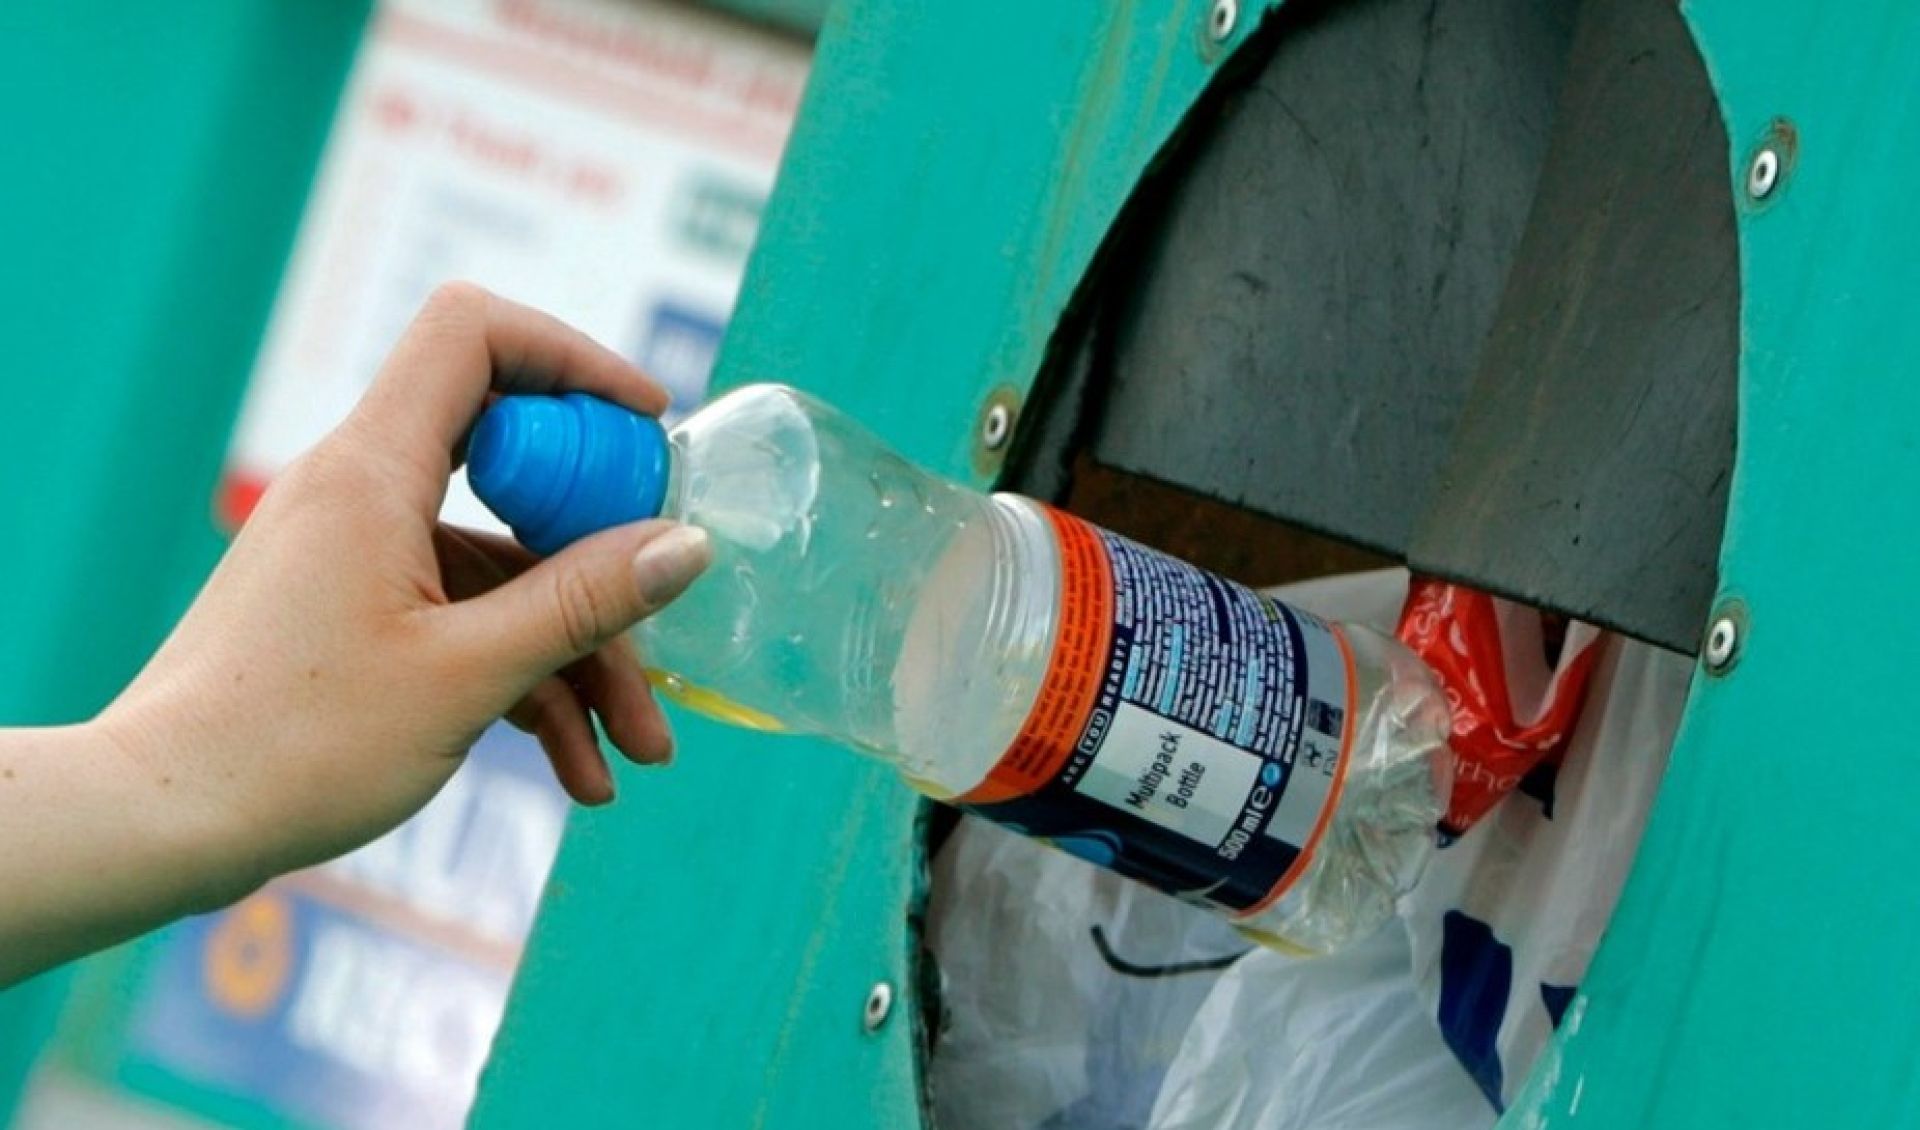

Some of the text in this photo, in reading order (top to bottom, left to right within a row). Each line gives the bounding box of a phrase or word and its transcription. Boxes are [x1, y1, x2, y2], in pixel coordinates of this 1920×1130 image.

[1082, 711, 1108, 752] YOU
[1102, 637, 1126, 707] READY?
[1125, 732, 1182, 809] Multipack
[1165, 762, 1205, 808] Bottle
